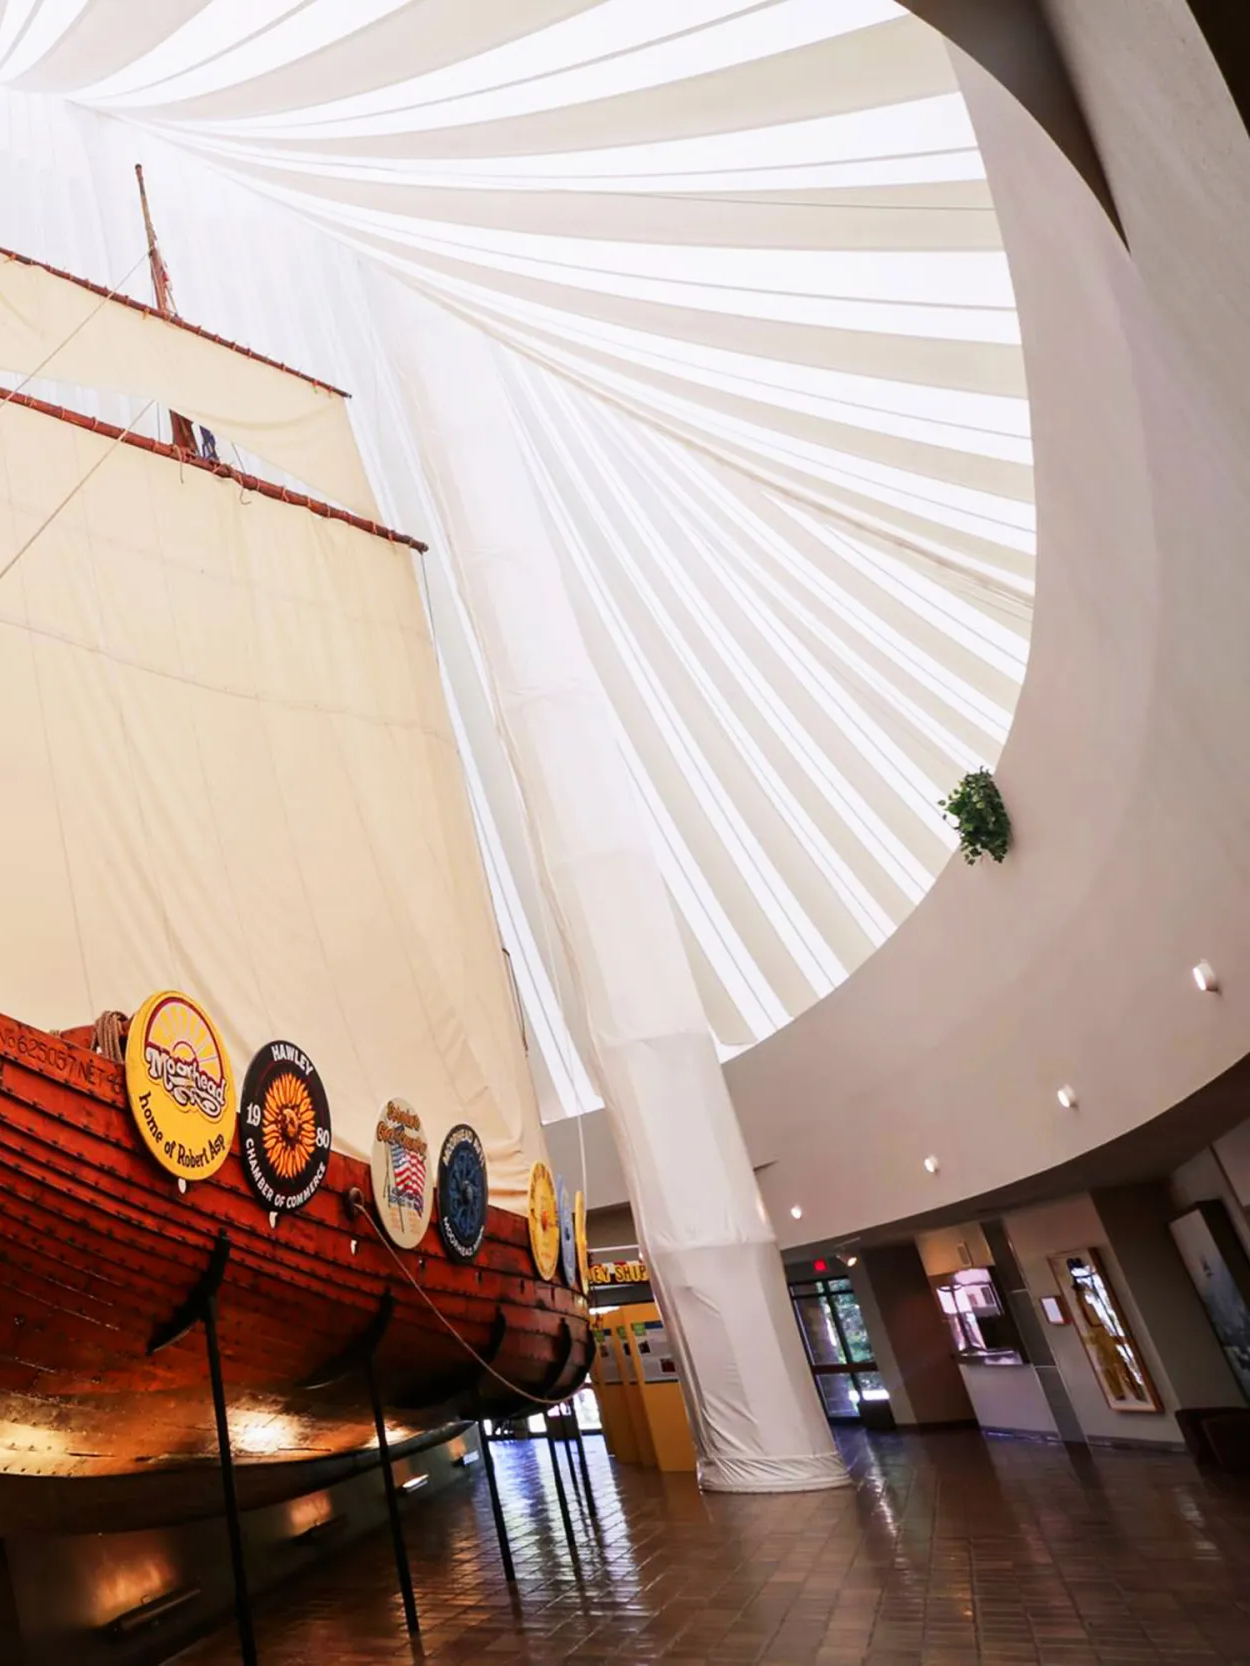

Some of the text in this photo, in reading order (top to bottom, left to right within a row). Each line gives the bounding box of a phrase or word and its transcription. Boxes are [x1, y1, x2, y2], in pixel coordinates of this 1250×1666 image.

[271, 1044, 313, 1077] HAWLEY
[146, 1046, 227, 1112] Moorhead
[139, 1091, 225, 1168] home of Robert Asp
[246, 1102, 261, 1127] 19
[315, 1126, 330, 1149] 80
[245, 1138, 326, 1209] CHAMBER OF COMMERCE
[615, 1264, 648, 1282] SHIP
